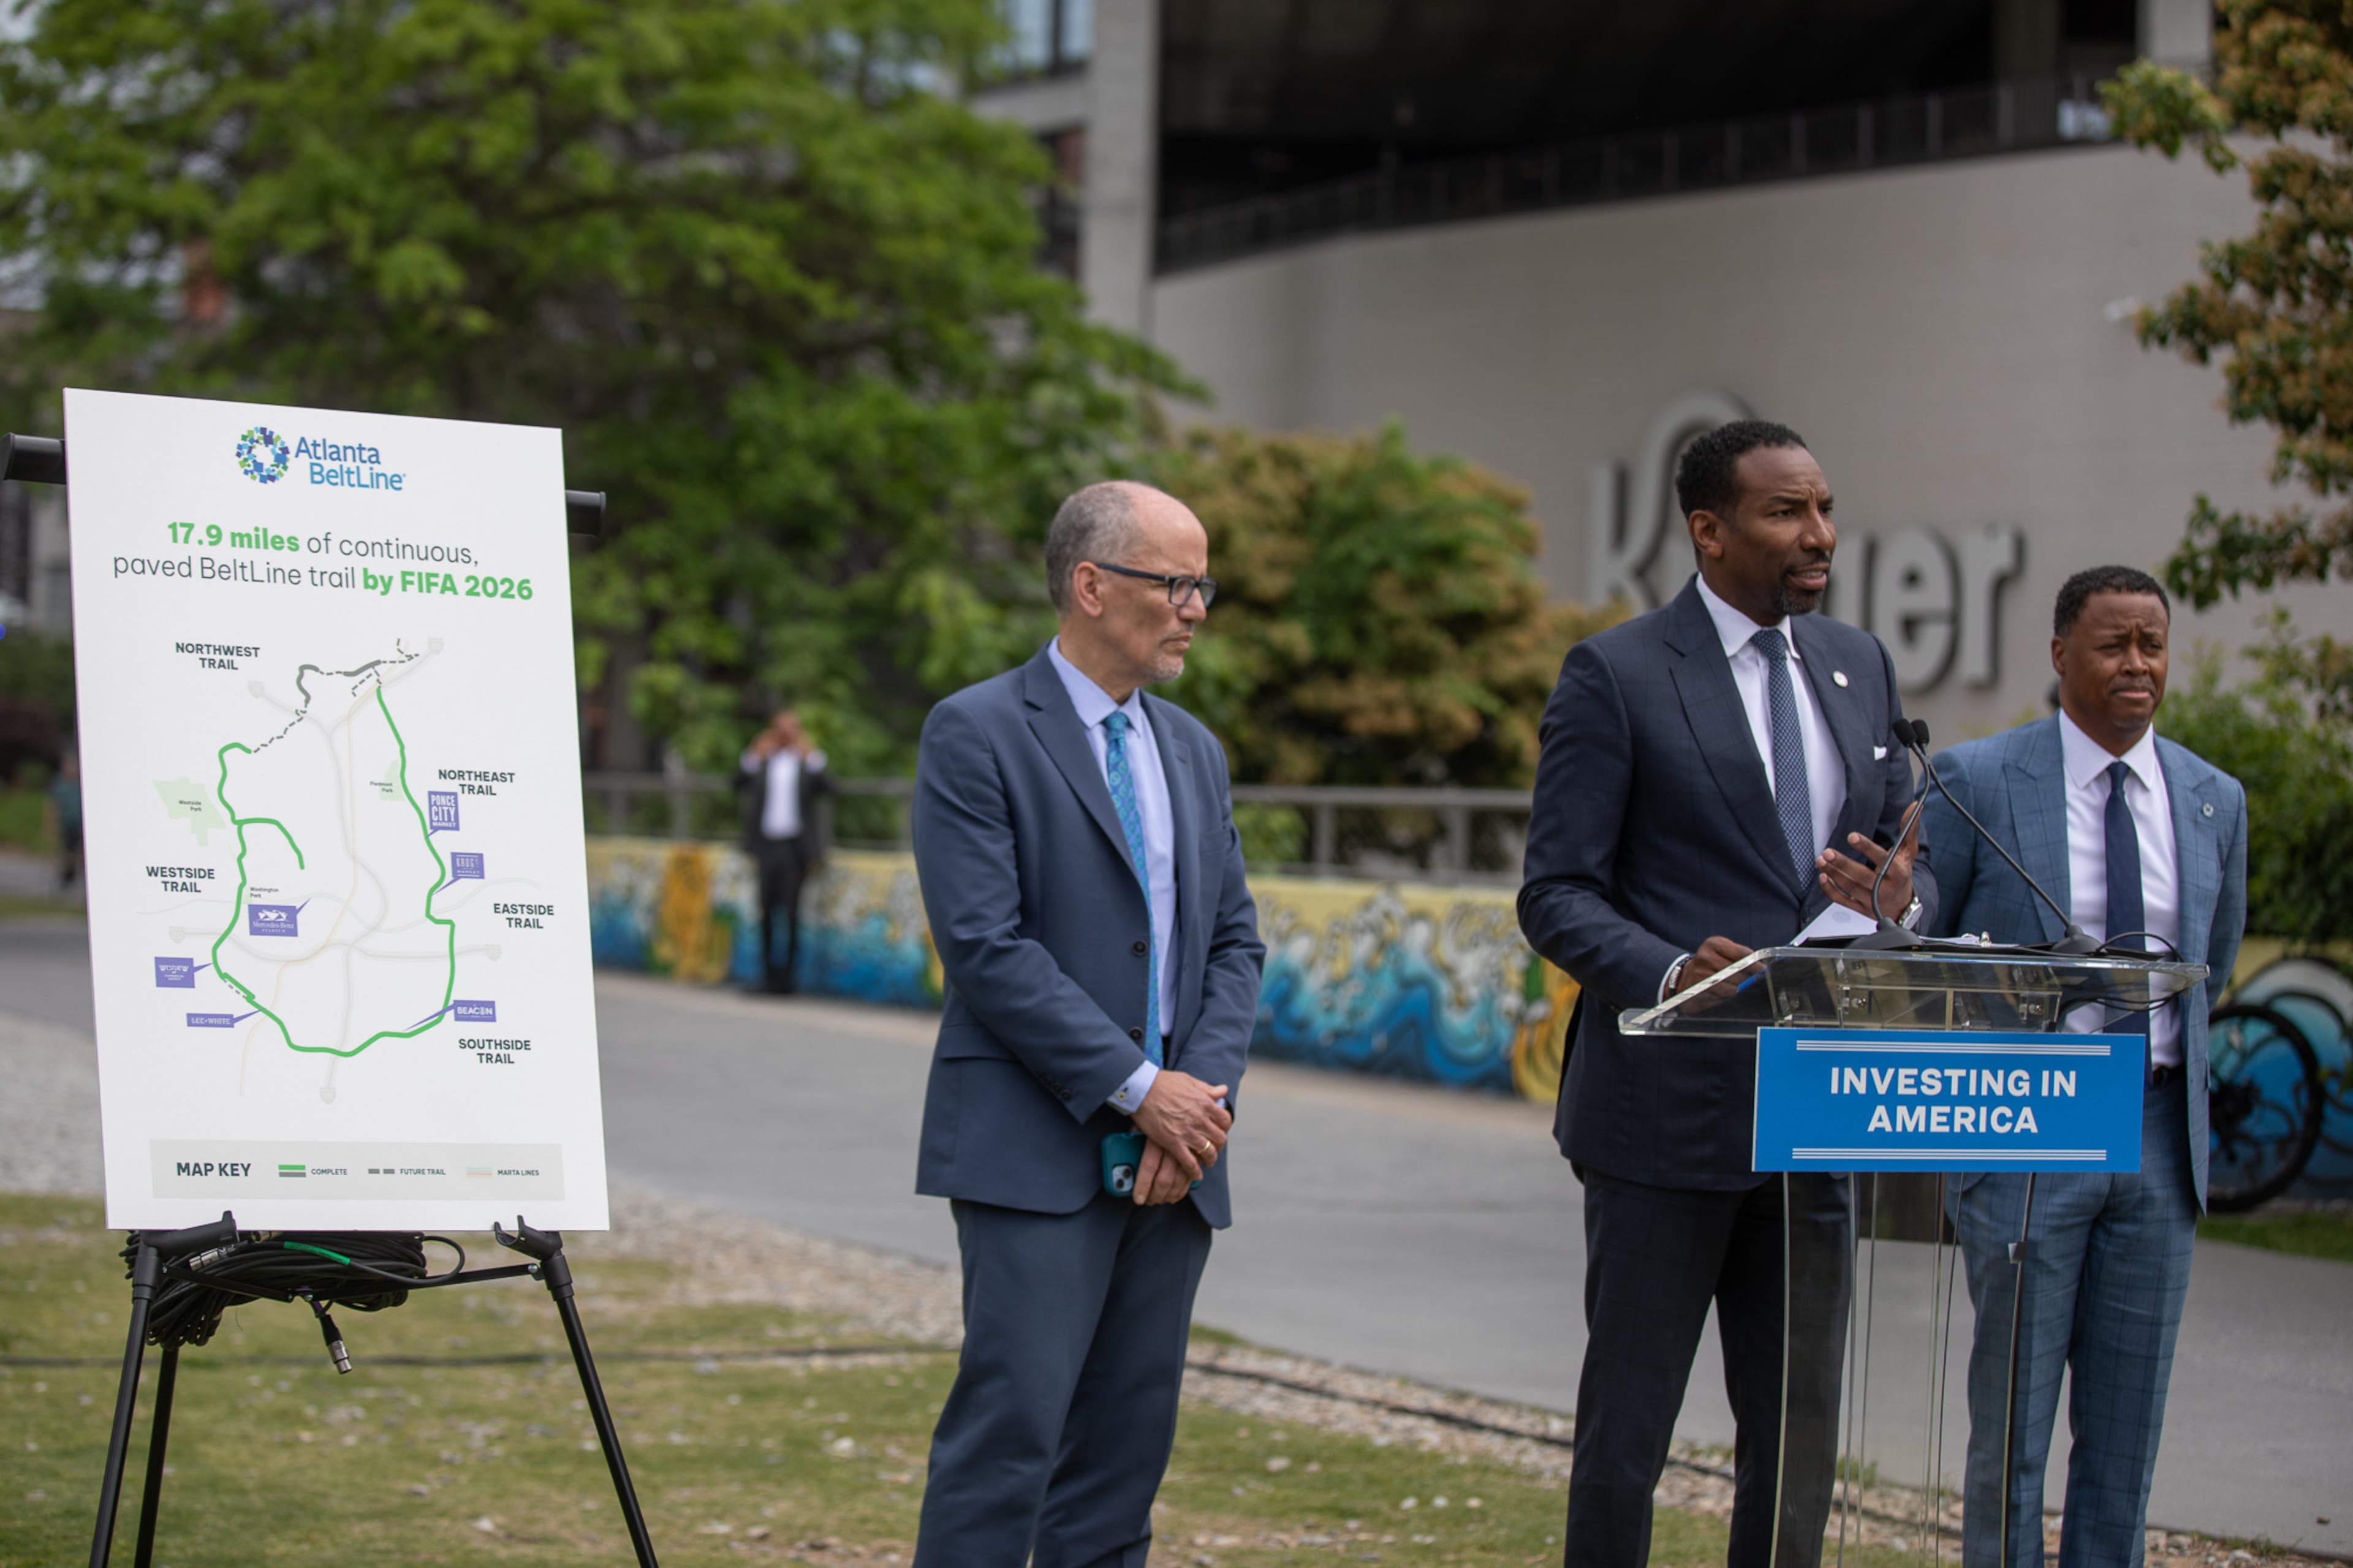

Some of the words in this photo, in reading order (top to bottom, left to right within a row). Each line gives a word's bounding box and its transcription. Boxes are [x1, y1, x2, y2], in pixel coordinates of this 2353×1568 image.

[295, 437, 381, 464] Atlanta
[167, 521, 222, 546] 17.9
[230, 528, 300, 551] miles
[307, 532, 331, 554] of
[339, 539, 478, 566] continuous,
[114, 556, 192, 578] paved
[200, 559, 301, 585] BeltLine
[308, 567, 355, 588] trail
[363, 567, 392, 594] by
[401, 573, 458, 596] FIFA
[464, 577, 532, 600] 2026
[176, 642, 260, 657] NORTHWEST
[199, 657, 238, 670] TRAIL
[439, 769, 515, 783] NORTHEAST
[459, 784, 496, 795] TRAIL
[431, 795, 455, 806] PONCE
[431, 806, 456, 822] CITY
[146, 866, 215, 879] WESTSIDE
[161, 881, 201, 893] TRAIL
[493, 903, 554, 915] EASTSIDE
[506, 917, 544, 929] TRAIL
[458, 1039, 531, 1050] SOUTHSIDE
[477, 1053, 515, 1064] TRAIL
[1831, 1067, 2030, 1097] INVESTING
[2041, 1070, 2076, 1097] IN
[1867, 1105, 2038, 1134] AMERICA
[176, 1162, 214, 1176] MAP
[218, 1163, 251, 1176] KEY
